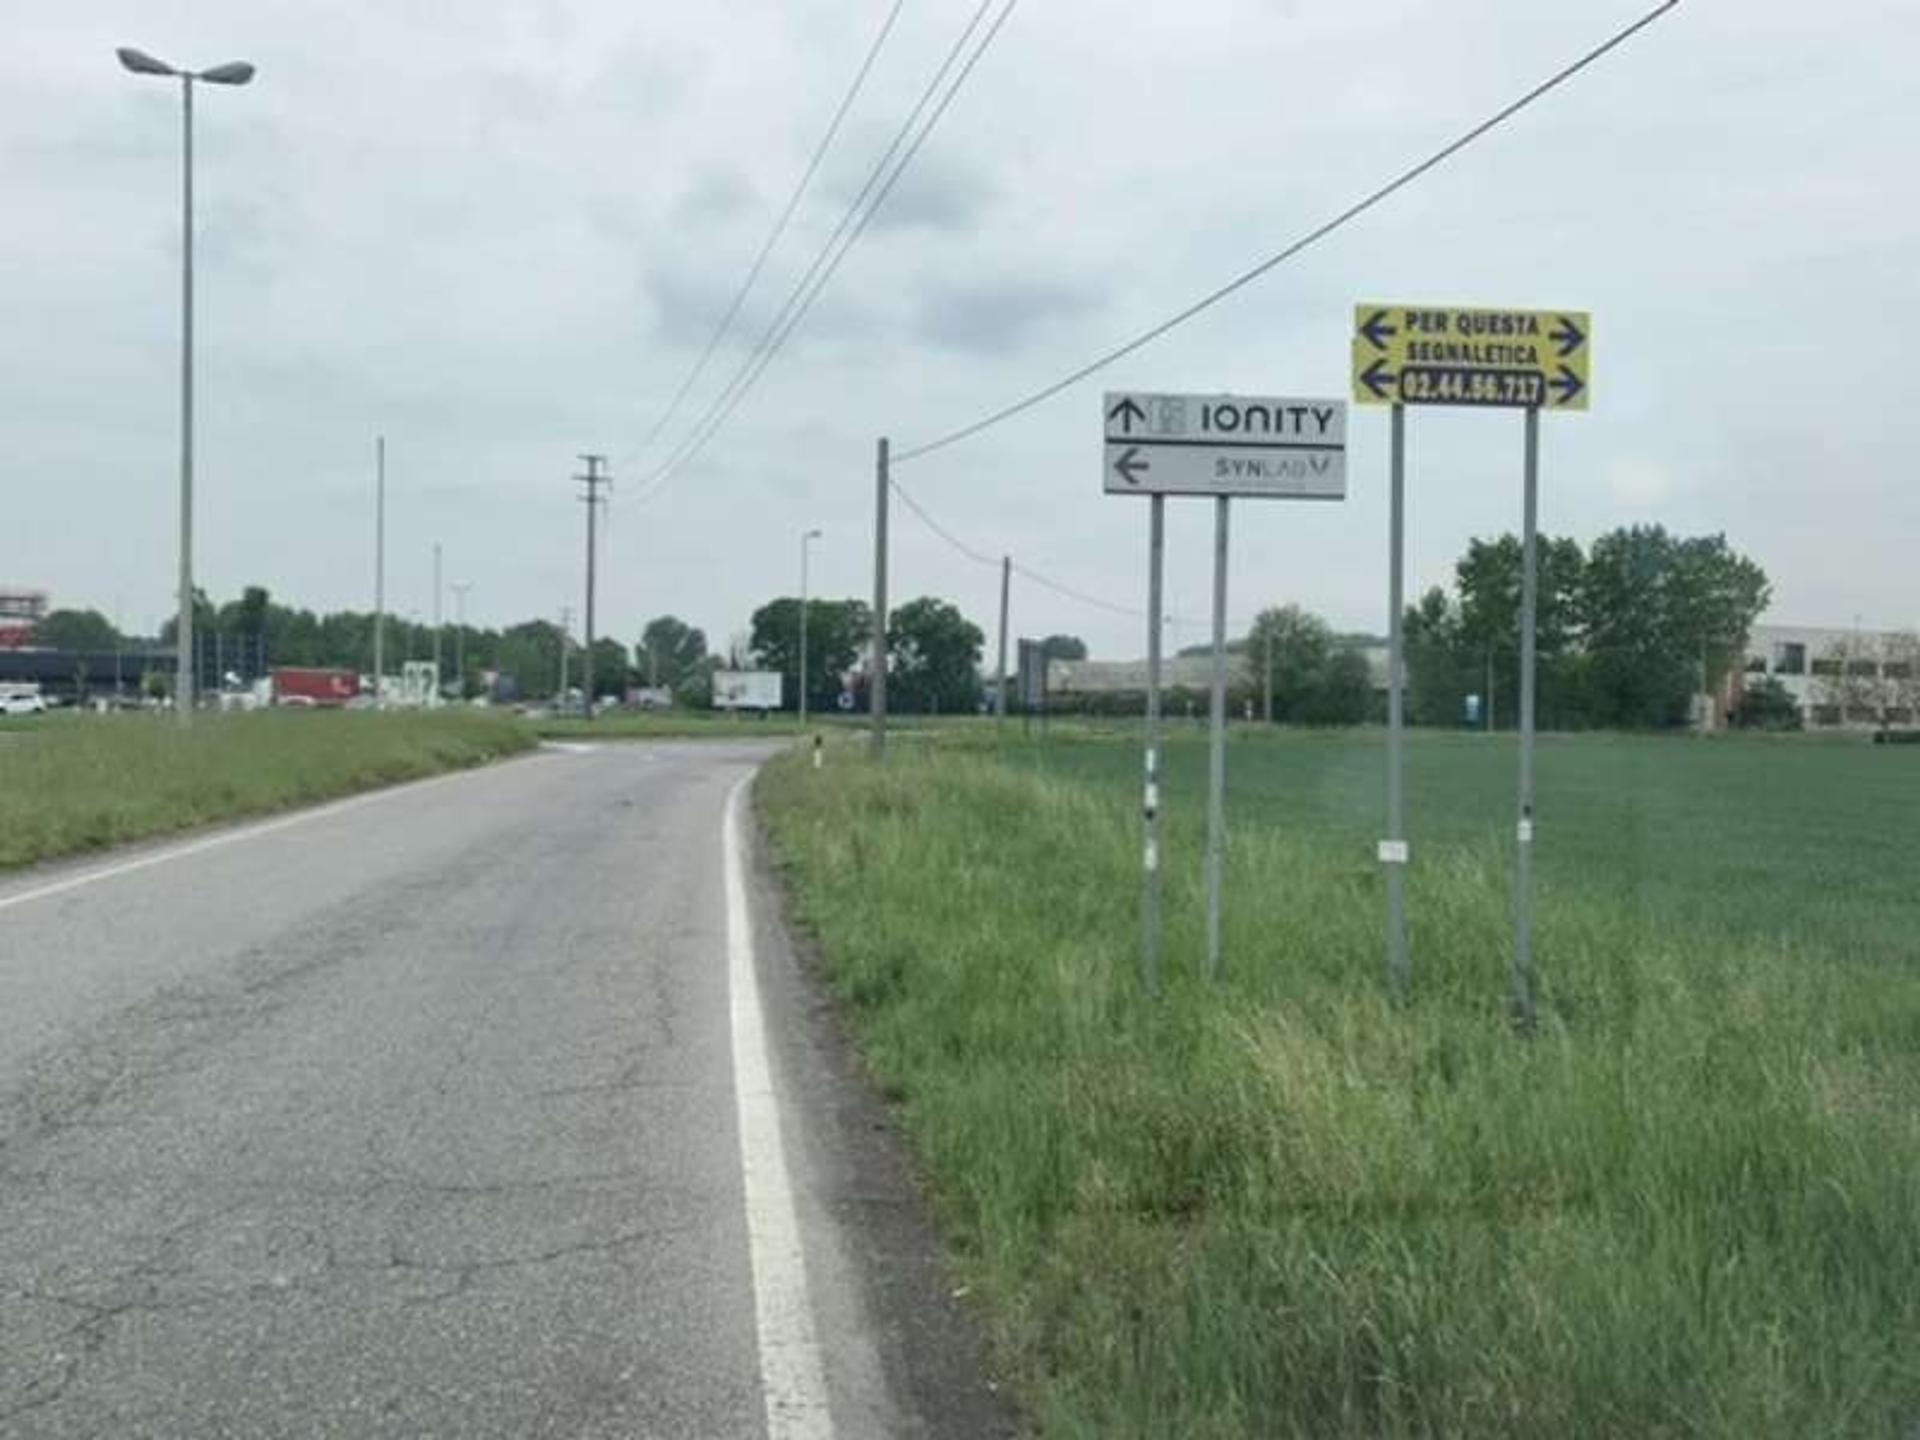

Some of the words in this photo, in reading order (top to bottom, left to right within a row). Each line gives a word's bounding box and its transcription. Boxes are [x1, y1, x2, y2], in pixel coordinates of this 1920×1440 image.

[1405, 311, 1448, 334] PER
[1456, 313, 1540, 337] QUESTA
[1406, 341, 1538, 364] SEGNALETICA
